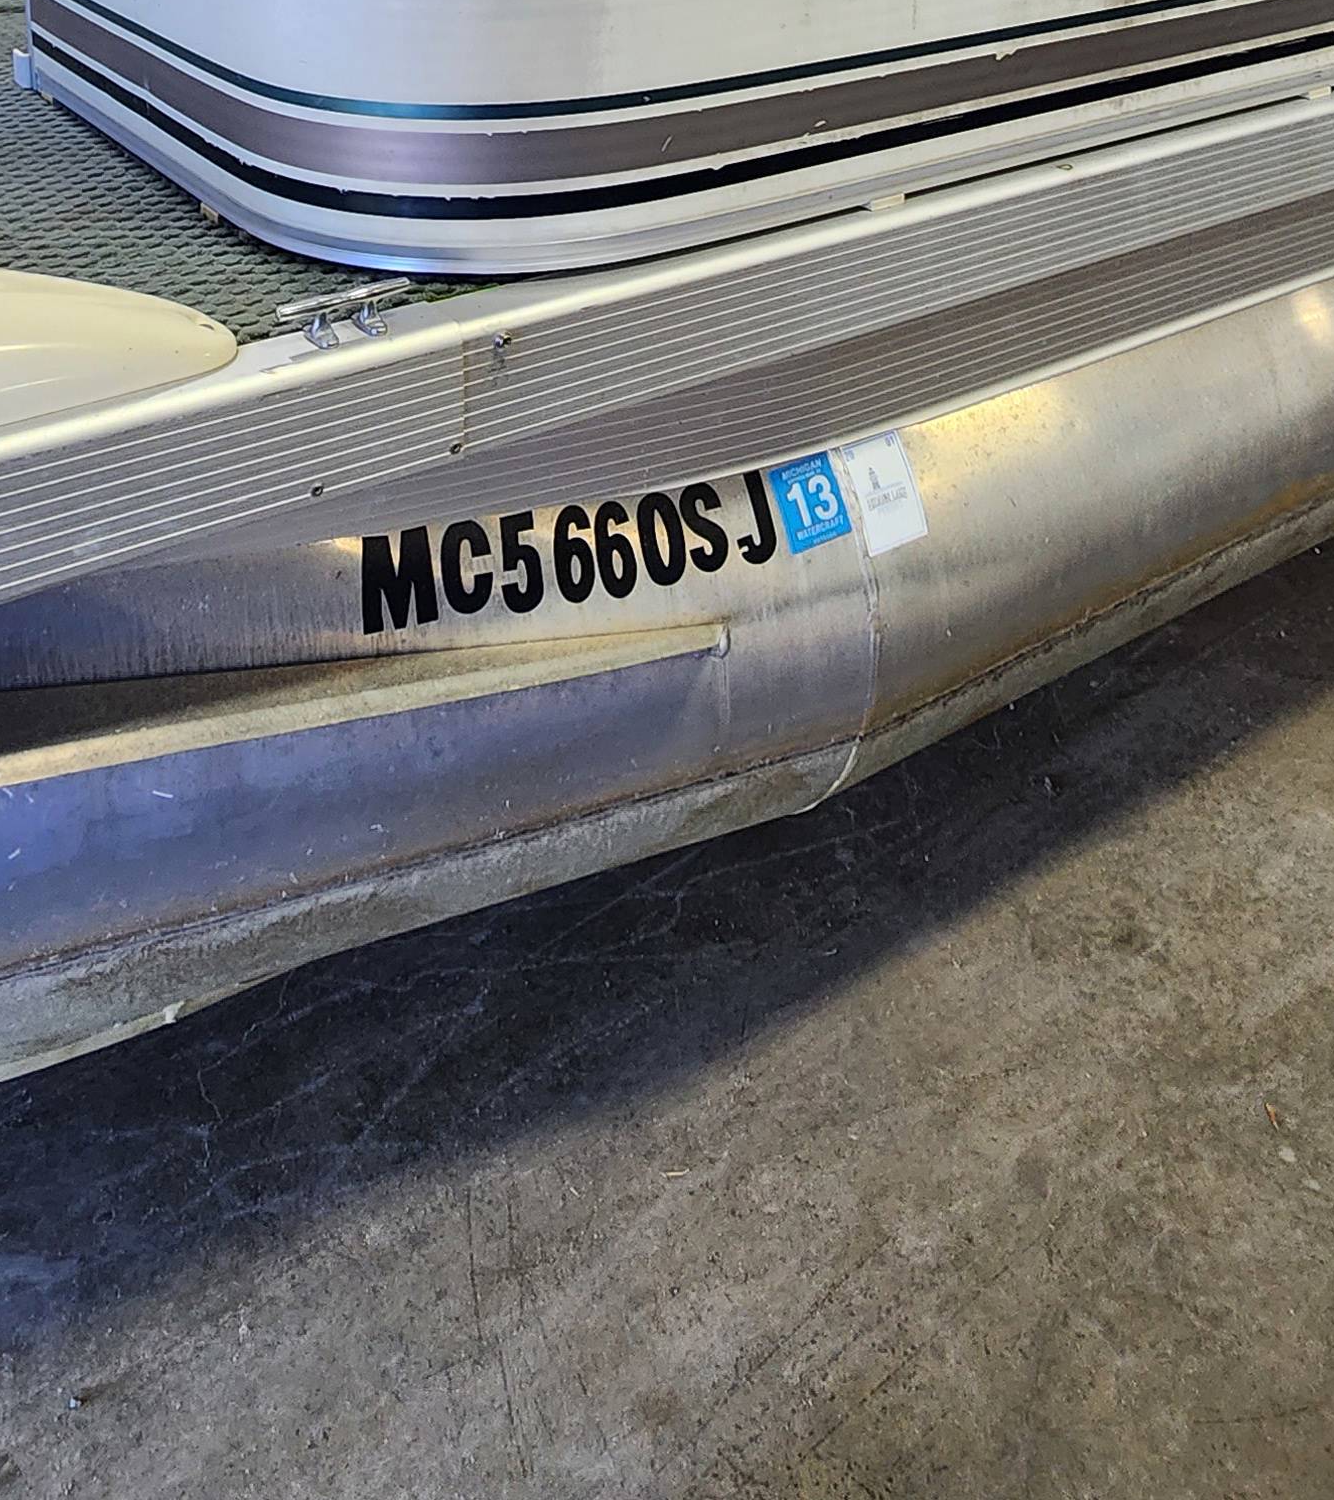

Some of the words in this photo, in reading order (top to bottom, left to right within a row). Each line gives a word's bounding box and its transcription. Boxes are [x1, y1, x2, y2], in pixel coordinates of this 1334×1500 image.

[781, 457, 822, 481] MICHIGAN
[786, 474, 839, 528] 13
[796, 514, 844, 541] WATERCRAFT
